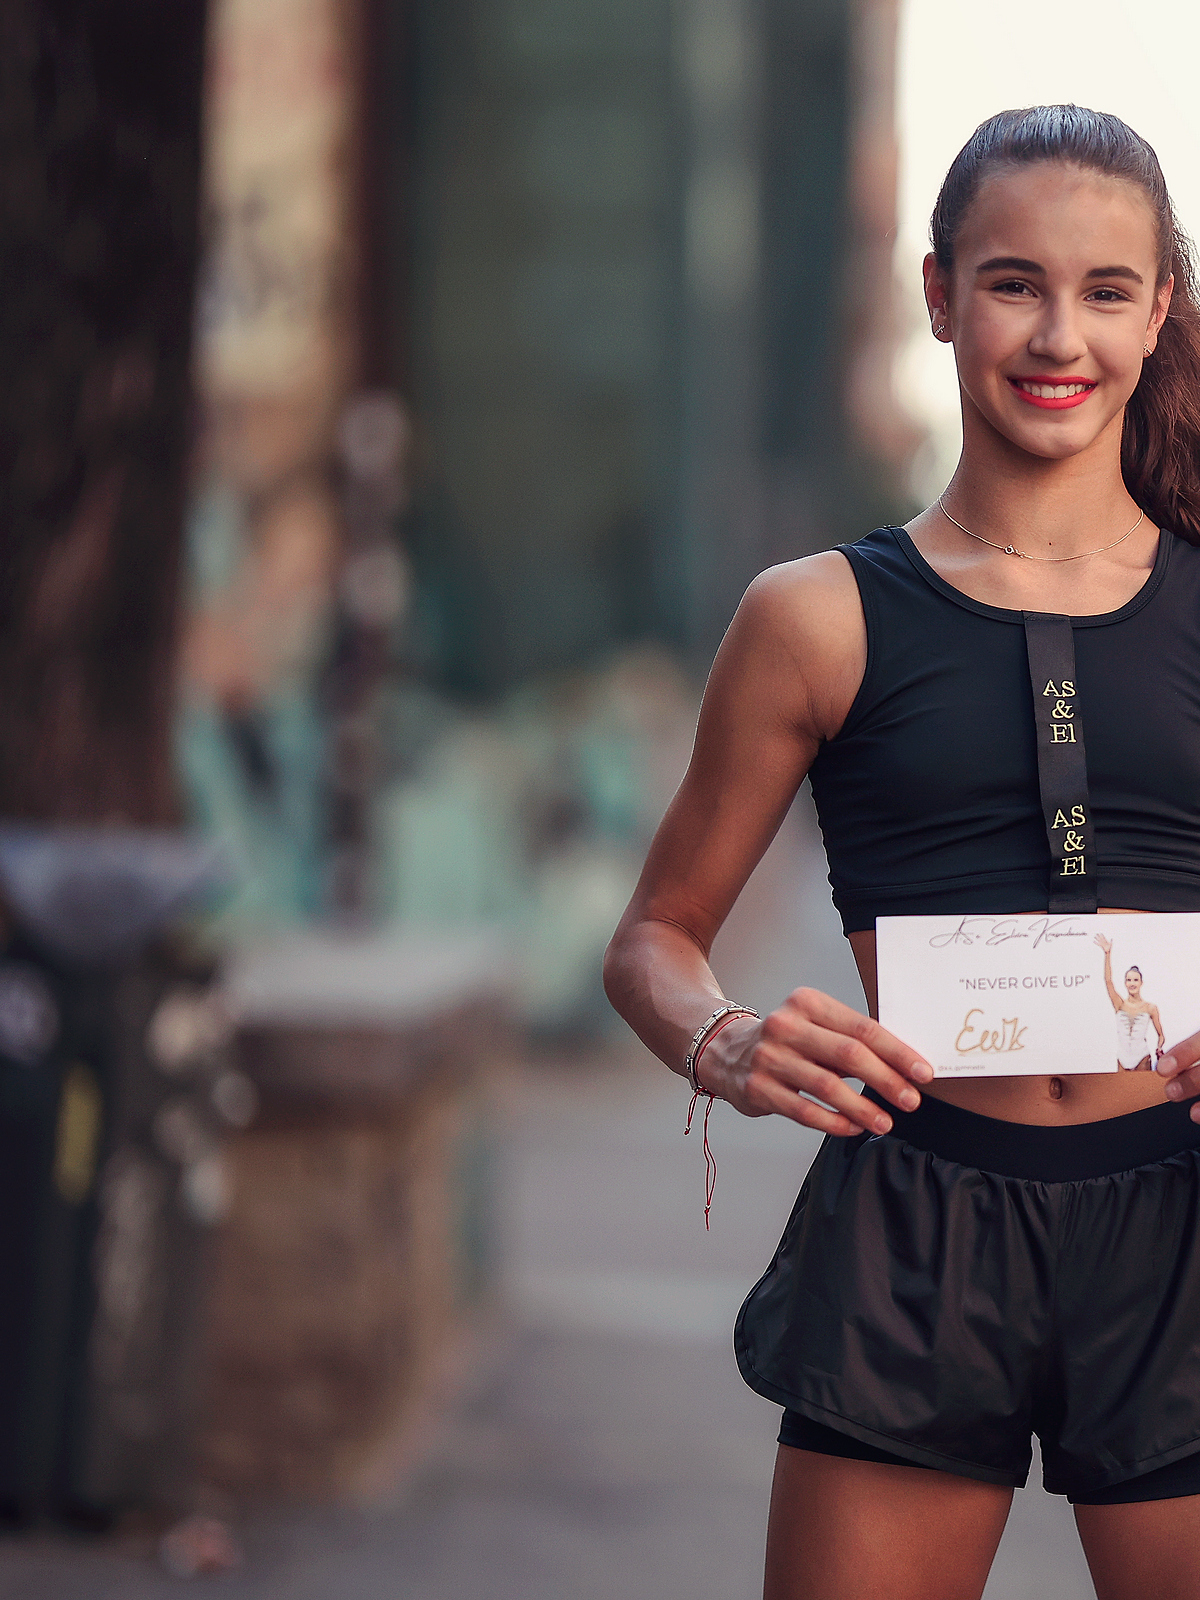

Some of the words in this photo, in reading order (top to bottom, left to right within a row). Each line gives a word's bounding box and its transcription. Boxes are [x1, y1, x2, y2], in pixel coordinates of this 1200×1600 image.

[1042, 679, 1076, 698] AS
[1051, 699, 1074, 719] &
[1051, 804, 1086, 829] AS
[1063, 830, 1085, 853] &
[959, 976, 1019, 990] “NEVER
[1021, 975, 1059, 989] GIVE
[1062, 974, 1091, 988] UP”
